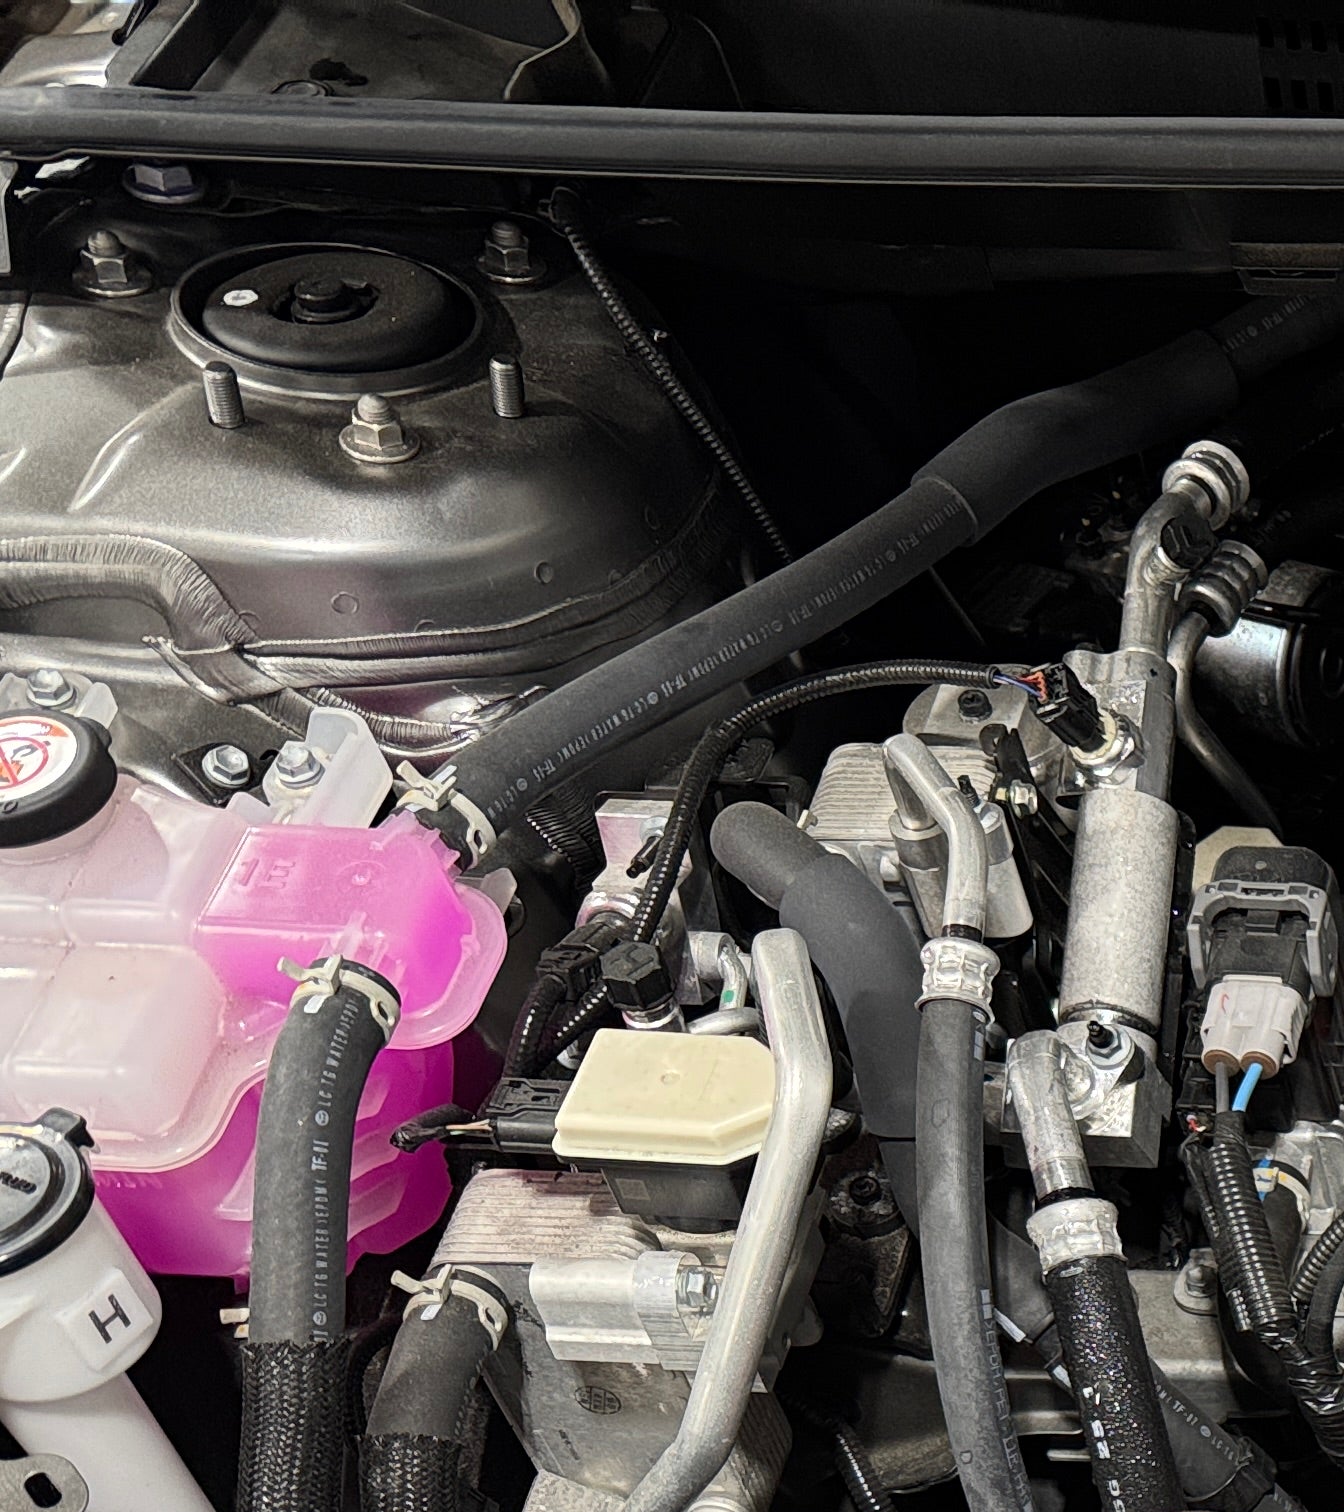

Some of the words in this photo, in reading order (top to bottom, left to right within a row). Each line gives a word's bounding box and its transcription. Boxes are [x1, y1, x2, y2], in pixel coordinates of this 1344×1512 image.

[326, 1028, 349, 1068] WATER
[318, 1089, 333, 1107] LC
[315, 1227, 330, 1269] WATER
[88, 1293, 131, 1344] H
[313, 1293, 328, 1308] LC
